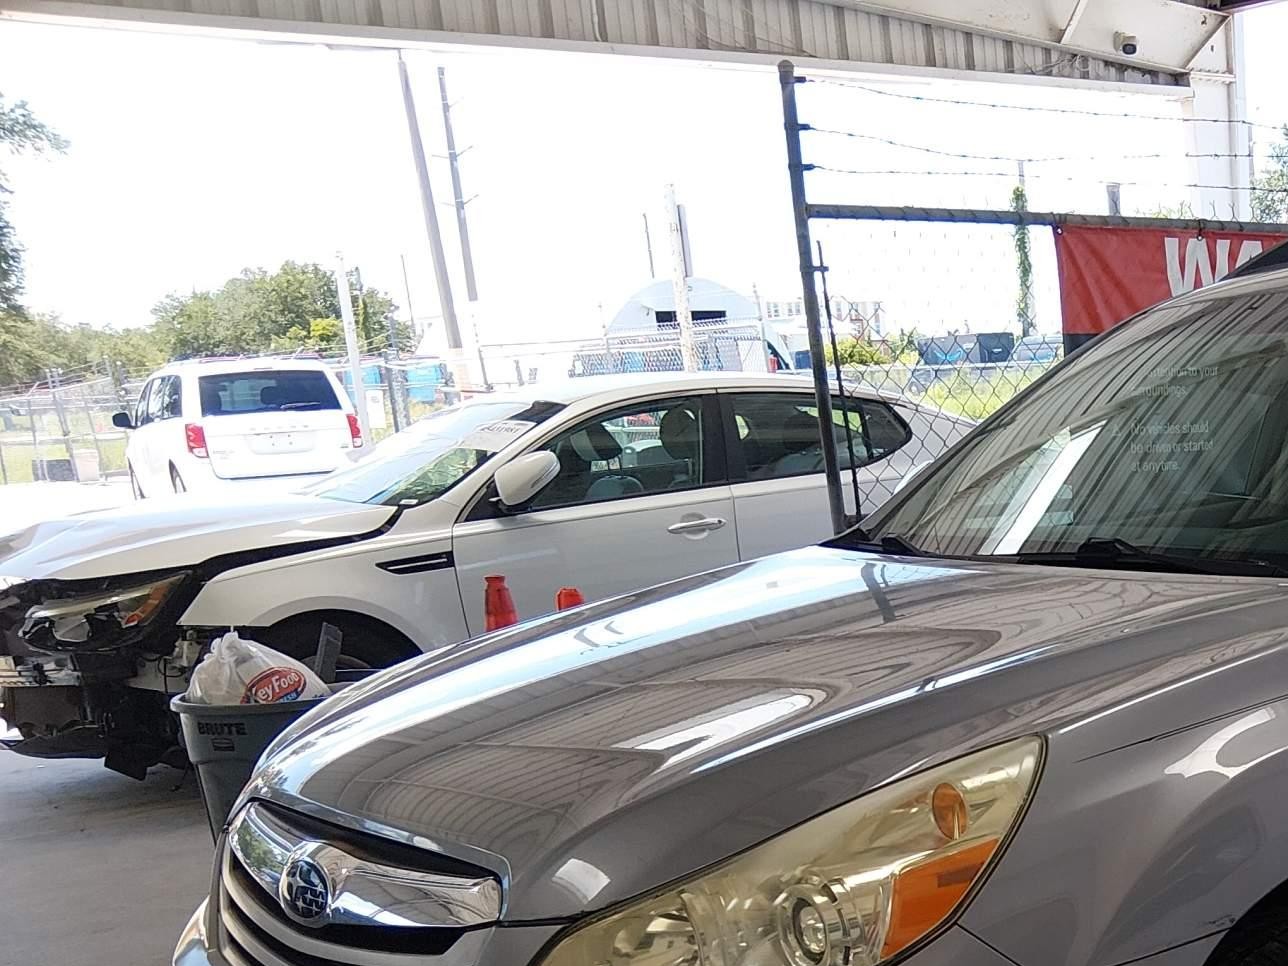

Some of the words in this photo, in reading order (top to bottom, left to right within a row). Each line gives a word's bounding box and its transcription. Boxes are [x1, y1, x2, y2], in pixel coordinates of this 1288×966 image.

[1182, 421, 1209, 433] should
[1131, 441, 1143, 453] be
[1184, 440, 1214, 452] started
[198, 722, 248, 736] BRUTE
